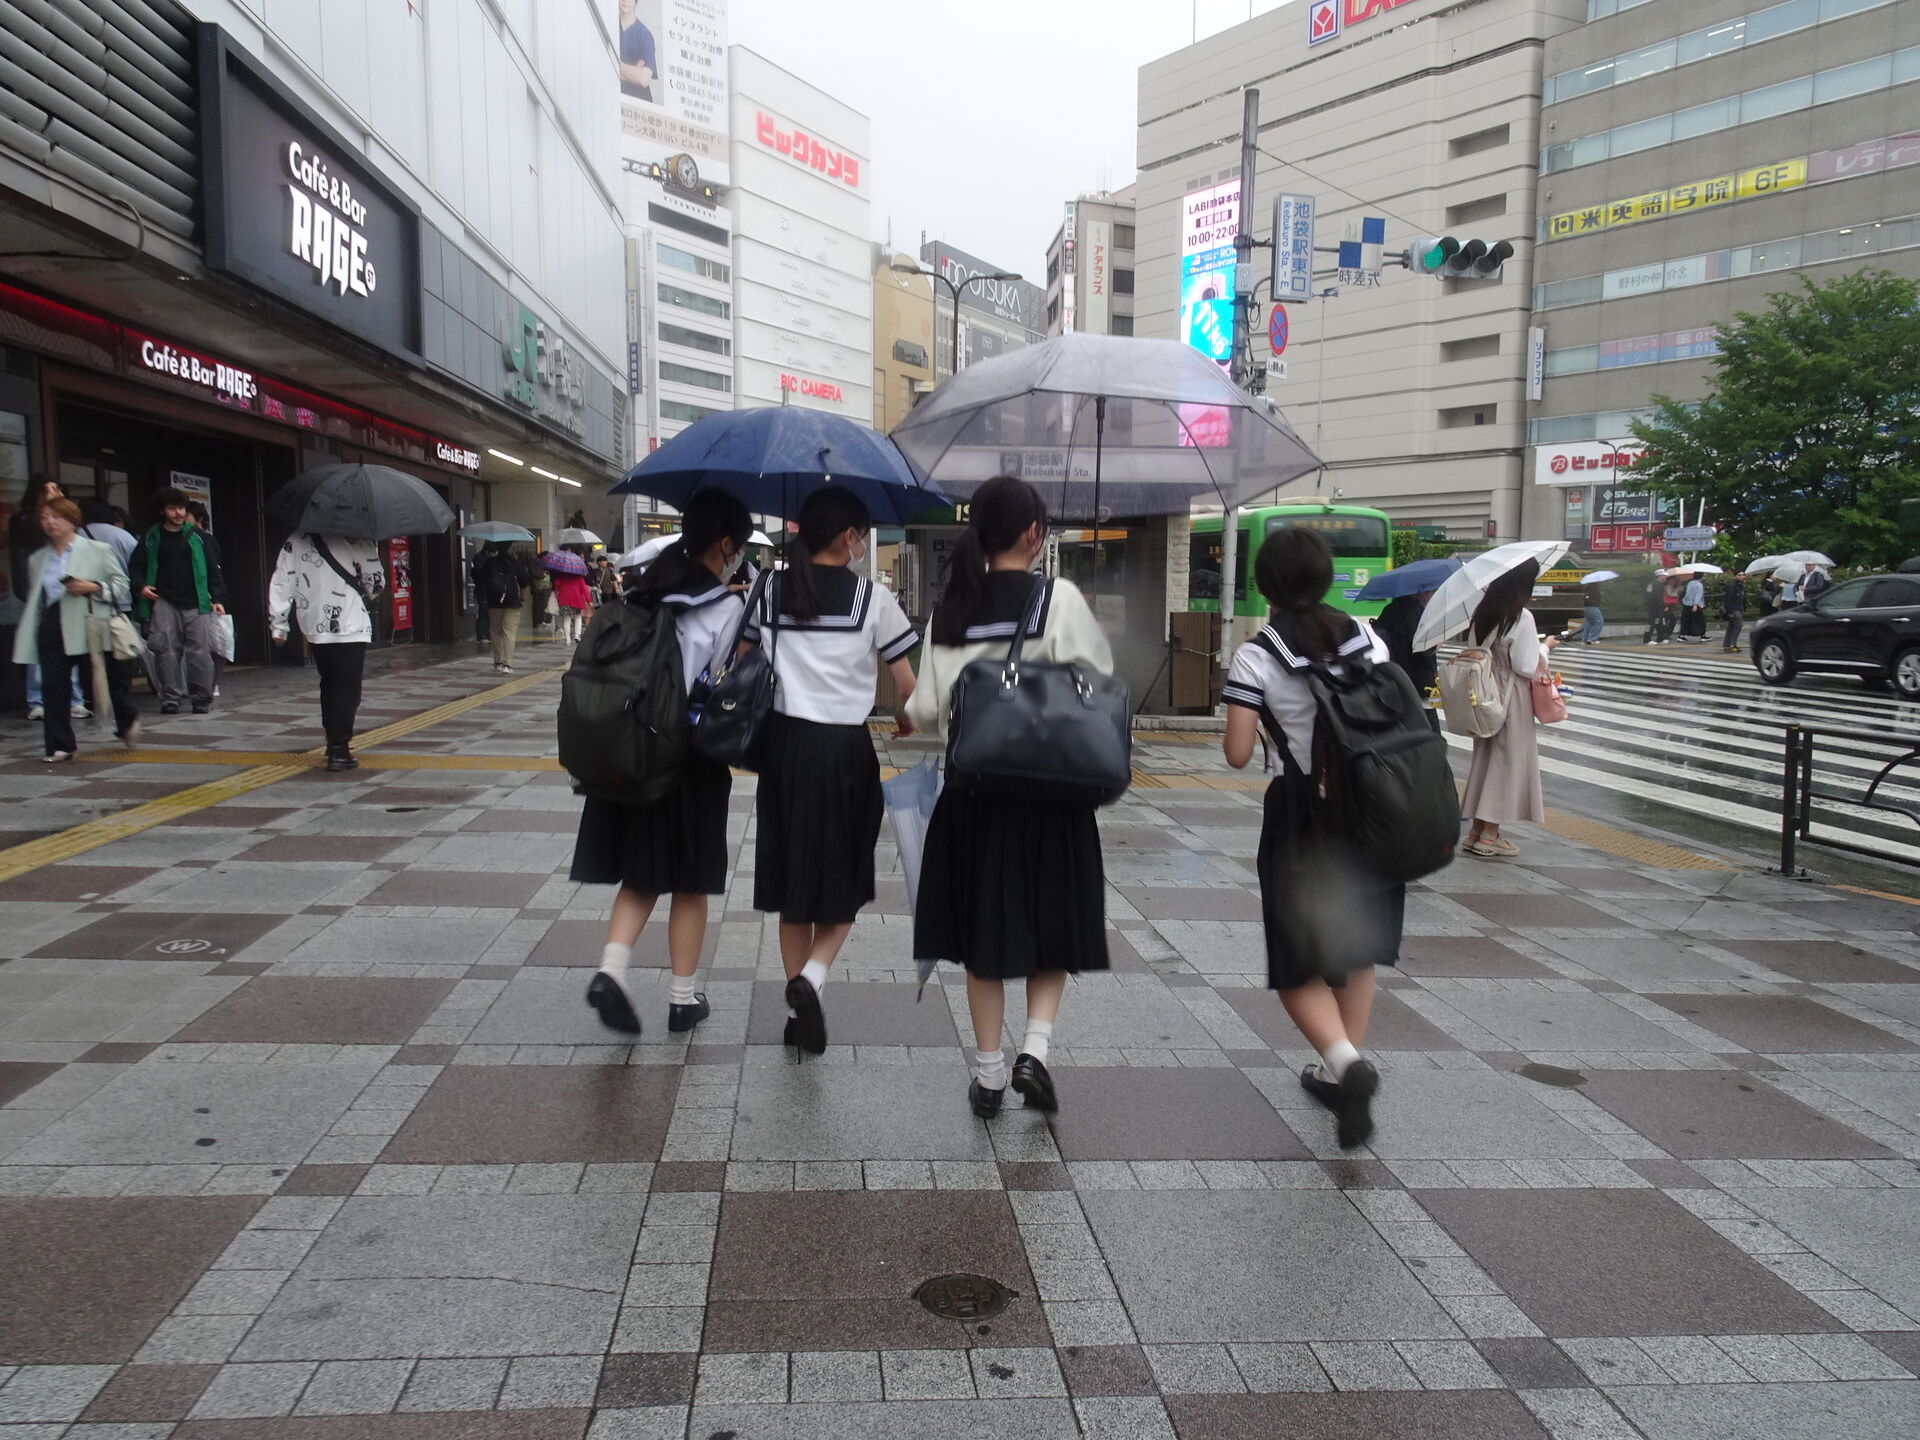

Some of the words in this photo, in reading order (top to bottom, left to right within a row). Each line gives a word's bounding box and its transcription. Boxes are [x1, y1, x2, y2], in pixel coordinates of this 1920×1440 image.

[756, 110, 860, 188] ビックカメラ
[1282, 201, 1292, 247] Ikebukuro
[1553, 179, 1730, 236] 日米英語学院
[1755, 165, 1789, 191] 6F
[289, 184, 369, 298] RAGE
[1291, 201, 1310, 293] 池袋駅東口
[969, 269, 1022, 314] OTSUKA
[1093, 244, 1105, 297] アデランス
[1338, 269, 1381, 288] 時差式
[215, 363, 253, 400] RAGE
[800, 378, 843, 402] CAMERA
